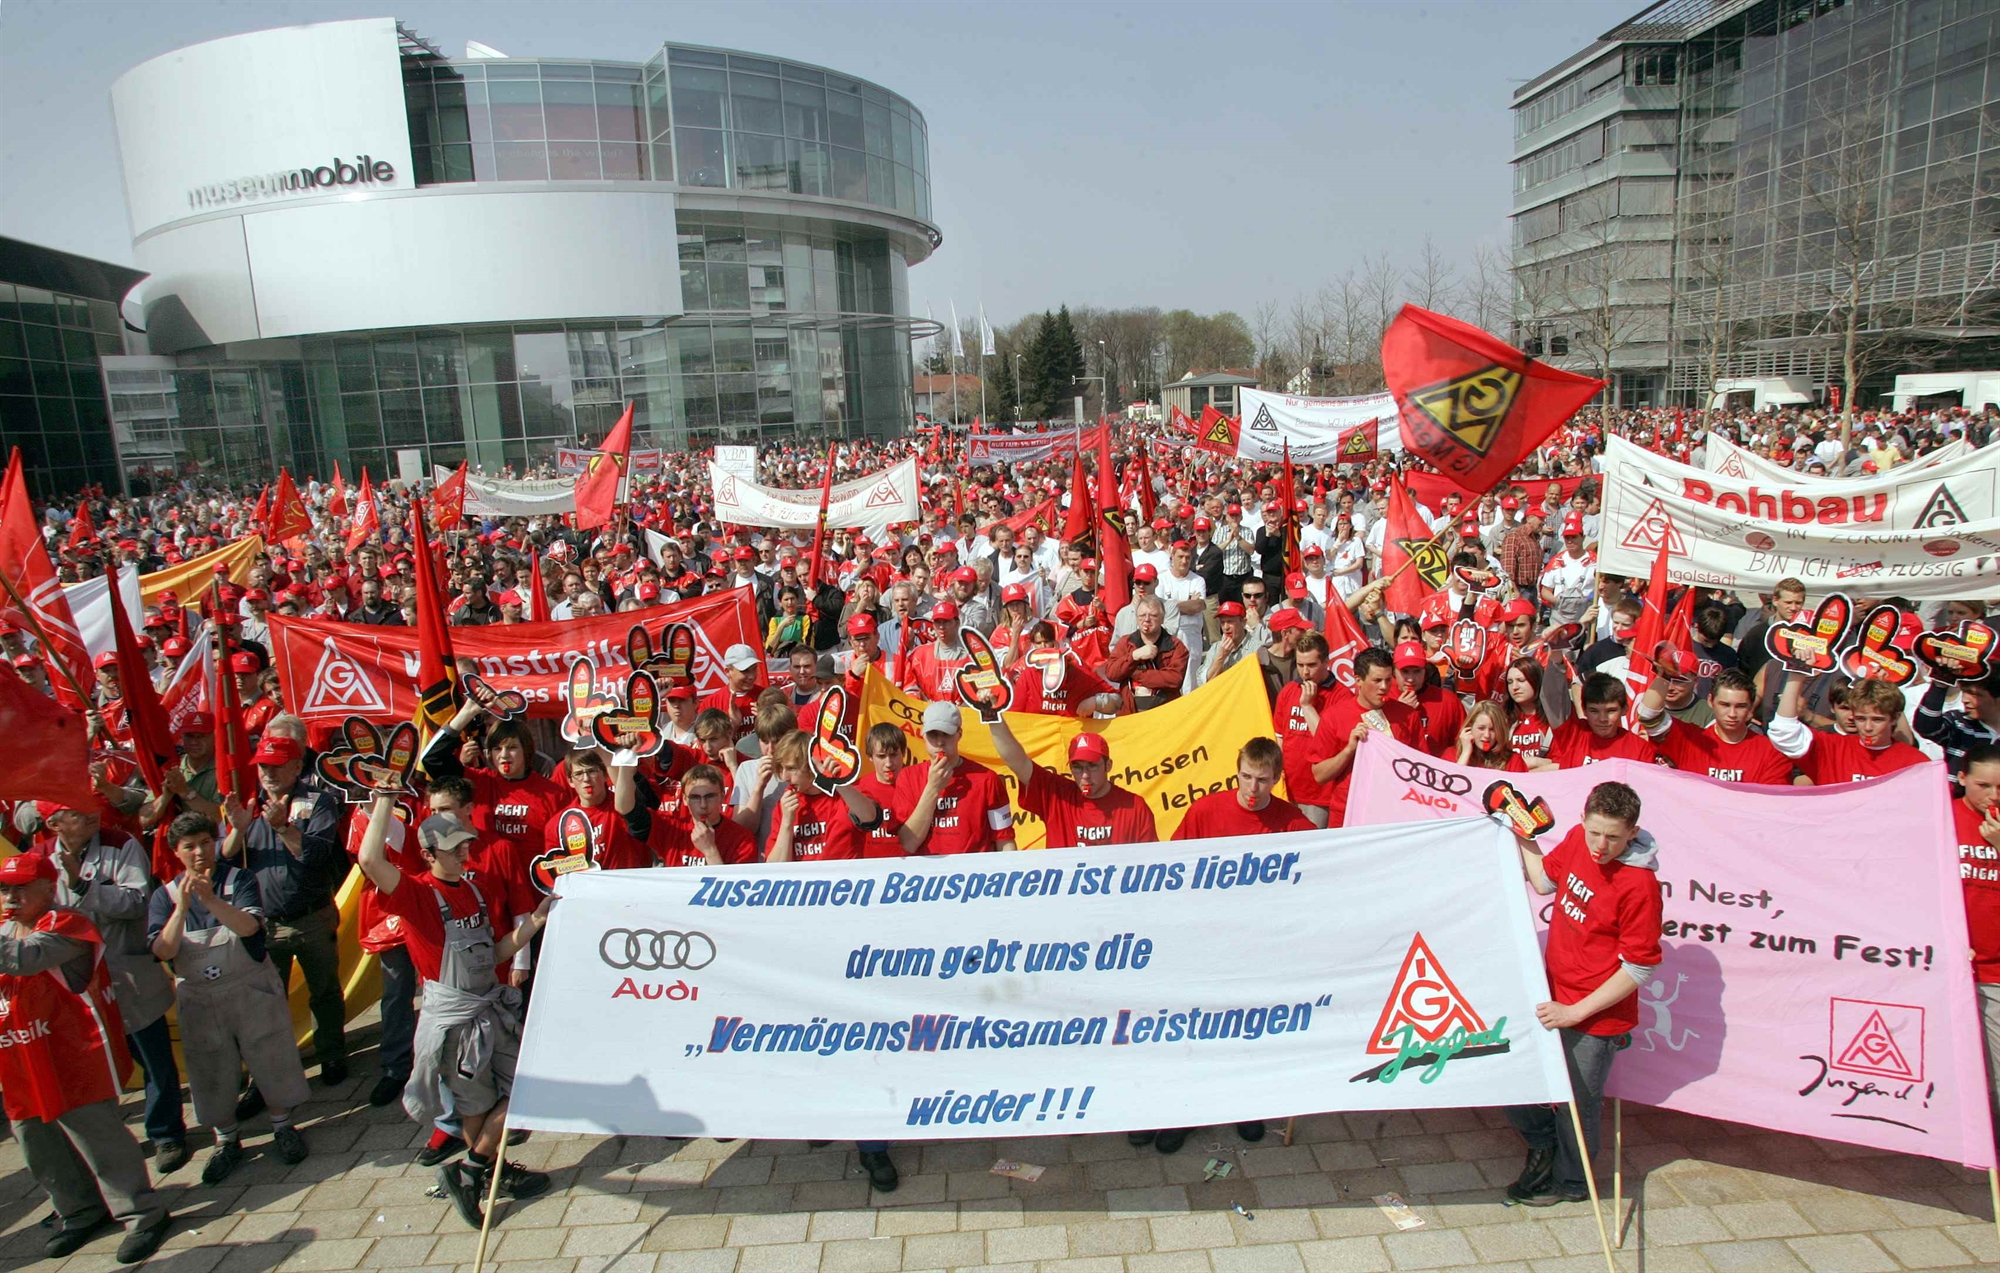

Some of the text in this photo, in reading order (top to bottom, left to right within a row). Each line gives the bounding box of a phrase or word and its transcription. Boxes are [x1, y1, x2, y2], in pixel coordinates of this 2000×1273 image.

[1285, 397, 1300, 407] Nur
[1303, 398, 1349, 408] gemeinsam
[1352, 397, 1370, 406] sind
[1682, 477, 1888, 526] Rohbau
[1744, 550, 1790, 575] BIN
[1800, 556, 1832, 578] ICH
[399, 638, 628, 678] Wnstreik
[1512, 732, 1541, 746] FIGHT
[1708, 766, 1744, 783] FIGHT
[936, 796, 959, 811] GHT
[793, 821, 827, 836] FIGHT
[932, 816, 960, 829] IGHT
[1076, 825, 1113, 841] FIGHT
[1958, 844, 1999, 860] FIGH
[688, 852, 1302, 909] Zusammen Bausparen ist uns lieber,
[1959, 862, 2000, 882] RIGH
[1689, 879, 1785, 920] Nest,
[845, 932, 1153, 980] drum gebt uns die
[1749, 930, 1817, 954] zum
[1833, 934, 1934, 972] Fest!
